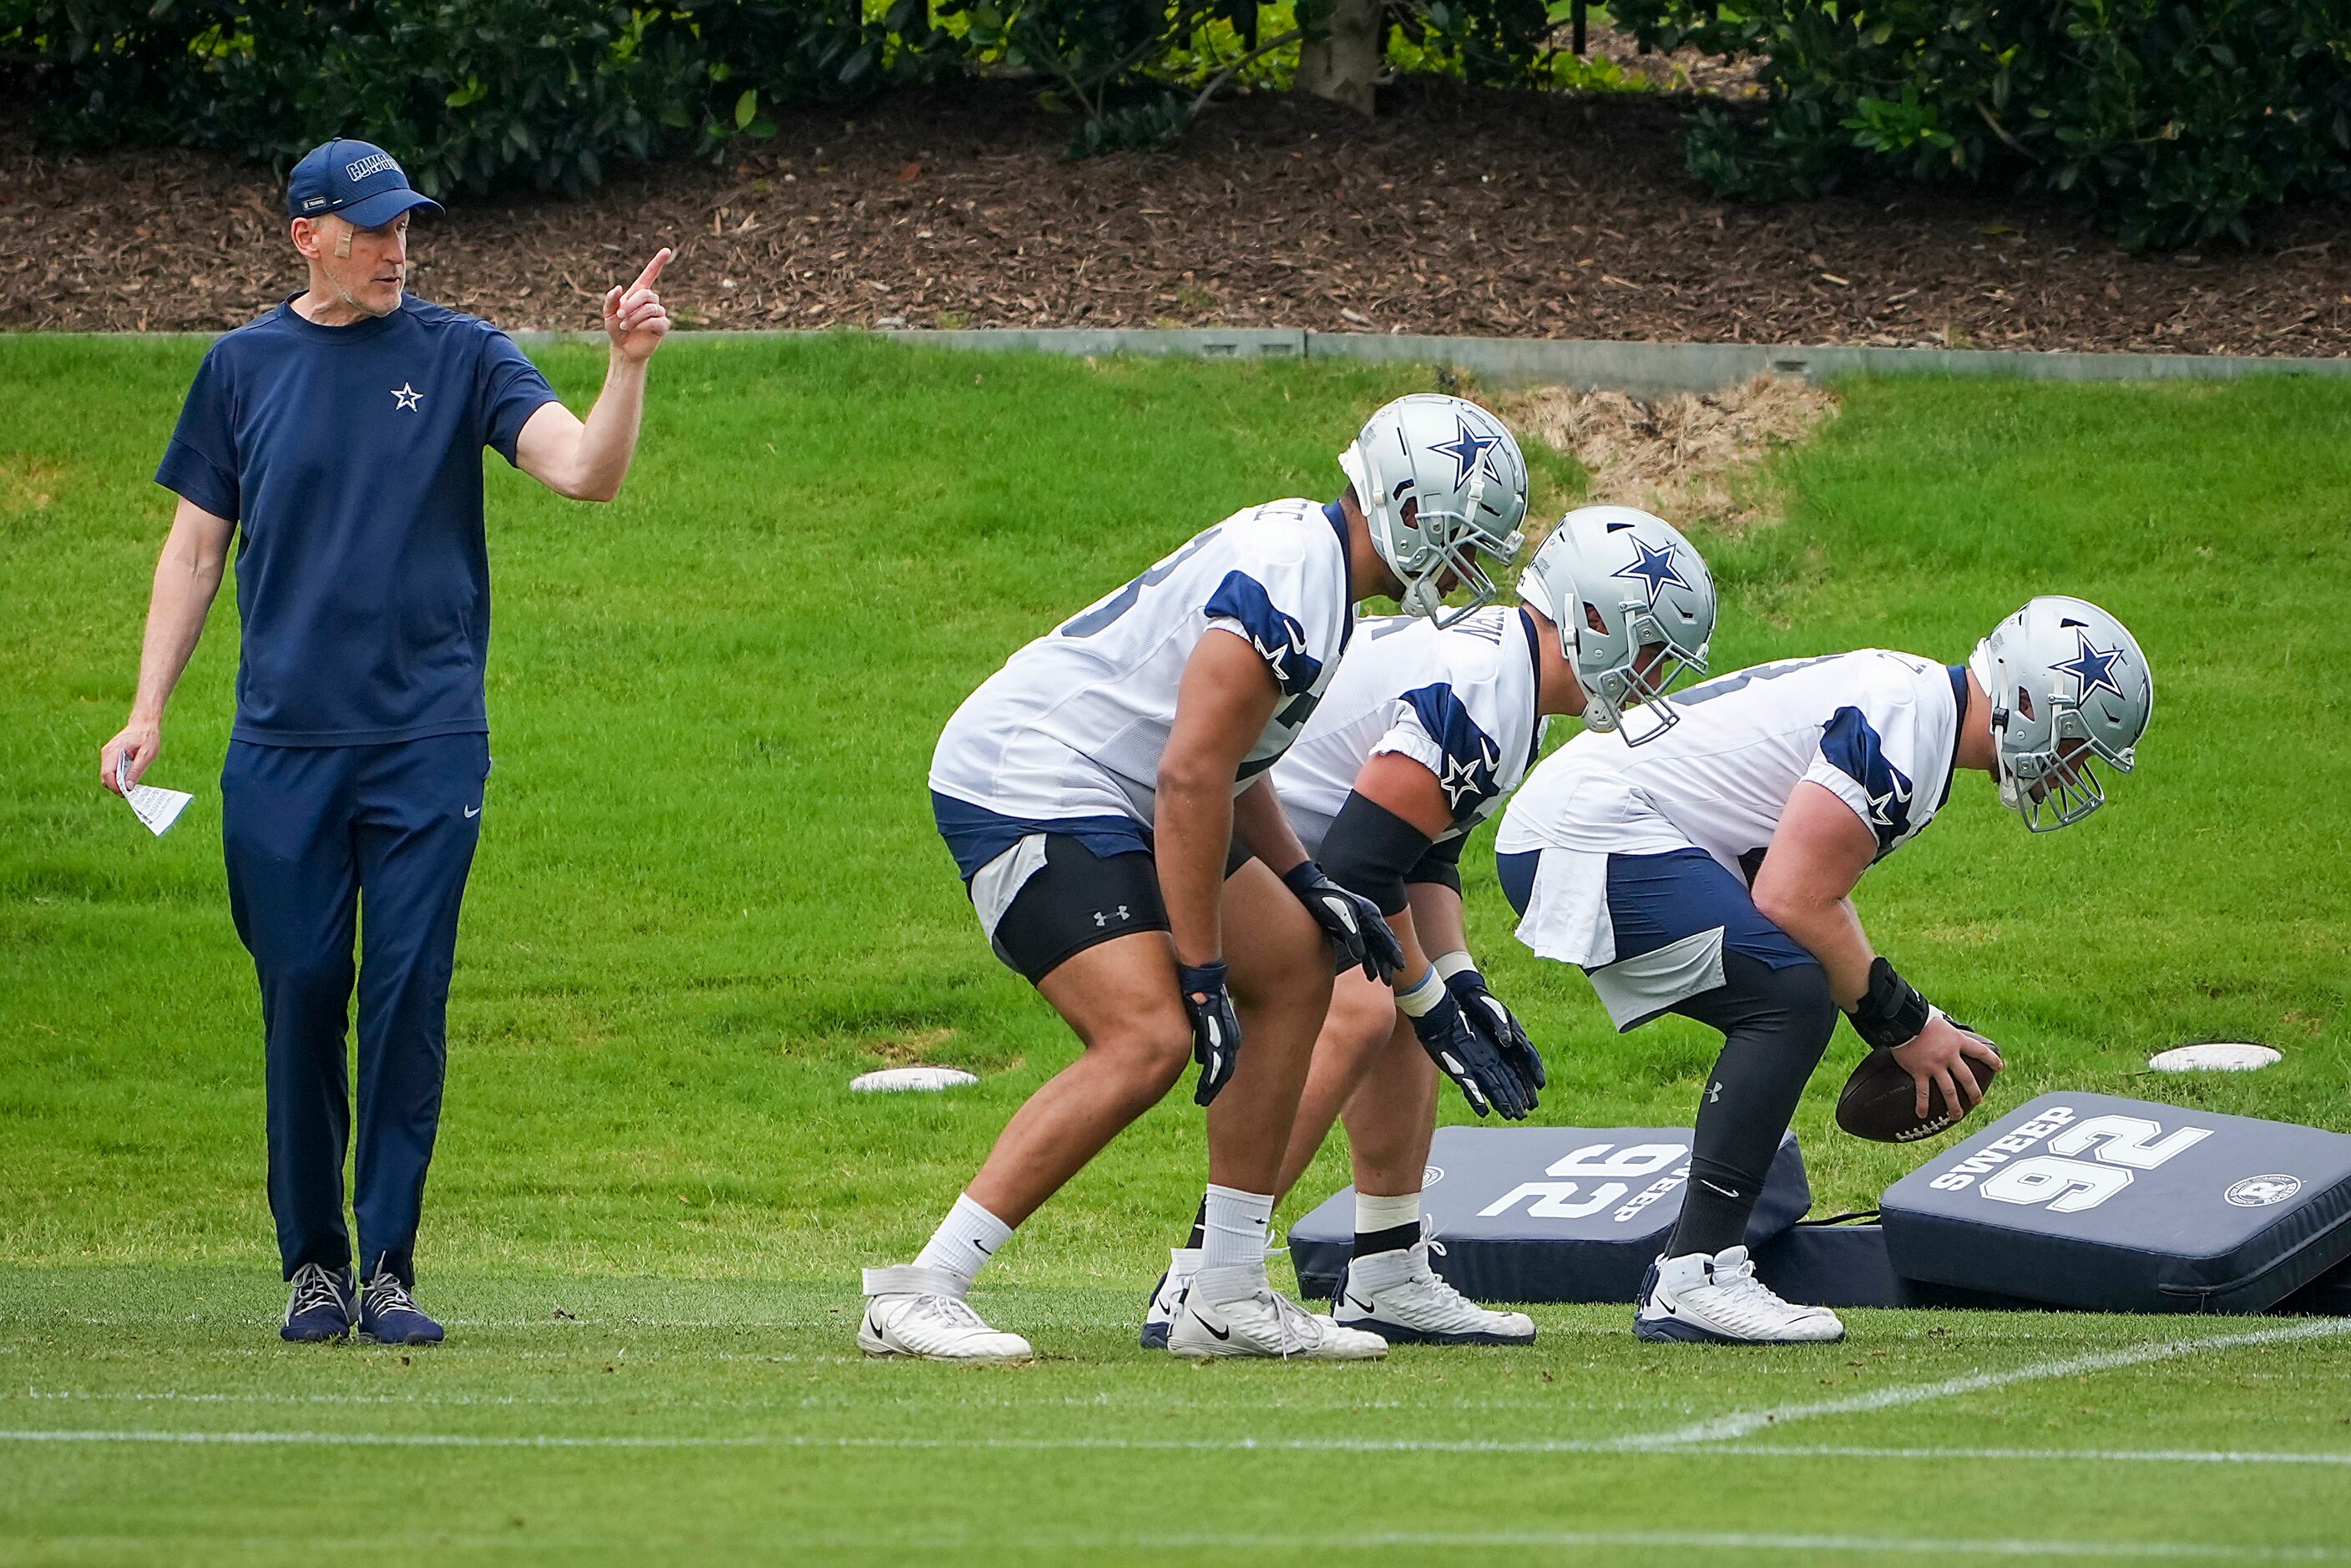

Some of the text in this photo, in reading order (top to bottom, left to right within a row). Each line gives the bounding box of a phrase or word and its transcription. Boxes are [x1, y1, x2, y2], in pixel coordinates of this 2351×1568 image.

[1475, 1143, 1689, 1218] 92
[1929, 1106, 2077, 1191] SWEEP
[1979, 1115, 2215, 1213] 92
